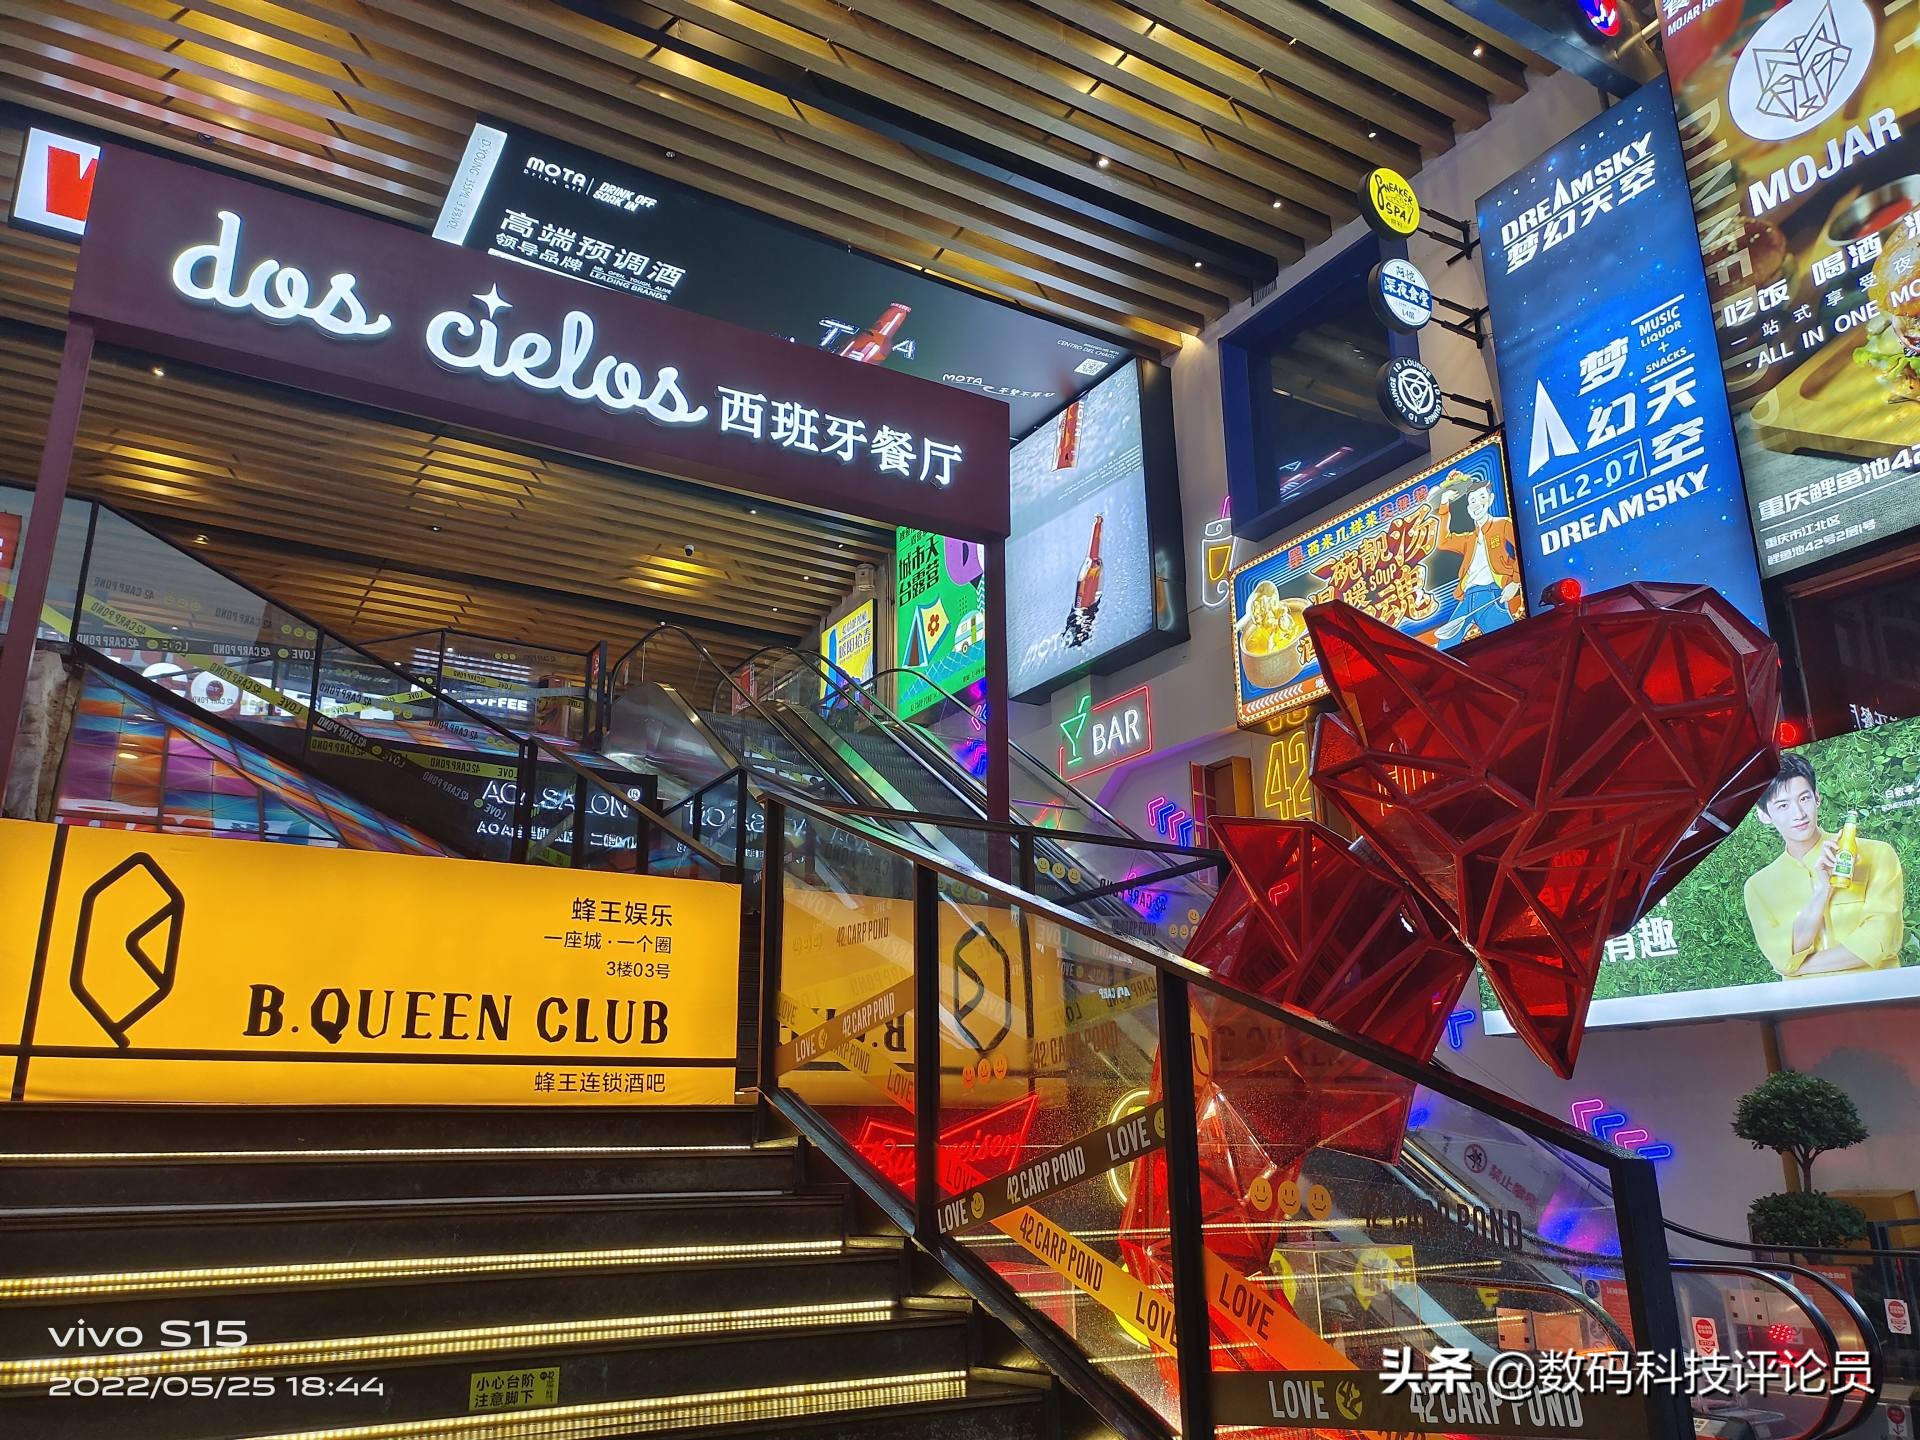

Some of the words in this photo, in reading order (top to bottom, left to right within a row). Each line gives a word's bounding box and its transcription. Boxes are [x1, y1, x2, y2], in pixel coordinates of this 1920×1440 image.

[1667, 7, 1701, 37] MOJAR
[526, 156, 588, 188] MOTA
[1749, 107, 1902, 217] MOJAR
[592, 189, 624, 209] SOAK
[623, 199, 639, 213] IN
[600, 181, 634, 202] DRINK
[634, 193, 658, 209] OFF
[1501, 131, 1652, 247] DREAMSKY
[1385, 201, 1407, 222] SPA
[1504, 159, 1656, 276] 梦幻天空
[495, 232, 584, 273] 领导品牌
[500, 208, 686, 288] 高端预调酒
[589, 271, 631, 289] LEADING
[630, 285, 669, 301] BRANDS
[1723, 278, 1791, 328] 吃饭
[1811, 231, 1884, 288] 喝酒
[172, 210, 392, 335] dos
[425, 285, 709, 425] cielos
[1638, 305, 1681, 337] MUSIC
[1640, 319, 1682, 348] LIQUOR
[1757, 344, 1795, 369] ALL
[1801, 325, 1825, 349] IN
[1833, 299, 1881, 335] ONE
[942, 373, 983, 386] MOTA
[1393, 362, 1402, 373] ID
[1402, 359, 1432, 379] LOUNGE
[1645, 346, 1688, 374] SNACKS
[1389, 376, 1407, 413] LOUNGE
[1423, 398, 1442, 425] LOUNGE
[716, 384, 965, 489] 西班牙餐厅
[1536, 449, 1641, 516] HL2-07
[1539, 463, 1710, 556] DREAMSKY
[1370, 563, 1398, 592] SOUP
[1092, 708, 1140, 756] BAR
[1265, 730, 1314, 821] 42
[570, 896, 673, 927] 蜂王娱乐
[543, 930, 673, 955] 一座城·一个圈
[836, 925, 847, 948] 42
[847, 921, 867, 946] CARP
[868, 917, 889, 940] POND
[605, 960, 671, 979] 3楼03号
[243, 983, 513, 1045] B.QUEEN
[536, 996, 669, 1045] CLUB
[795, 1032, 816, 1062] LOVE
[842, 1014, 852, 1038] 42
[852, 1003, 872, 1034] CARP
[873, 991, 895, 1023] POND
[533, 1071, 666, 1094] 蜂王连锁酒吧
[849, 1047, 870, 1074] POND
[887, 1068, 913, 1105] LOVE
[938, 1198, 969, 1234] LOVE
[1006, 1174, 1021, 1205] 42
[1019, 1160, 1052, 1199] CARP
[1052, 1146, 1087, 1190] POND
[1107, 1115, 1151, 1162] LOVE
[1456, 1203, 1523, 1250] POND
[1019, 1212, 1036, 1242] 42
[1034, 1222, 1069, 1265] CARP
[1069, 1246, 1104, 1292] POND
[1135, 1291, 1178, 1346] LOVE
[1219, 1273, 1275, 1341] LOVE
[474, 1389, 535, 1409] 注意脚下
[476, 1372, 535, 1392] 小心台阶
[1268, 1379, 1330, 1420] LOVE
